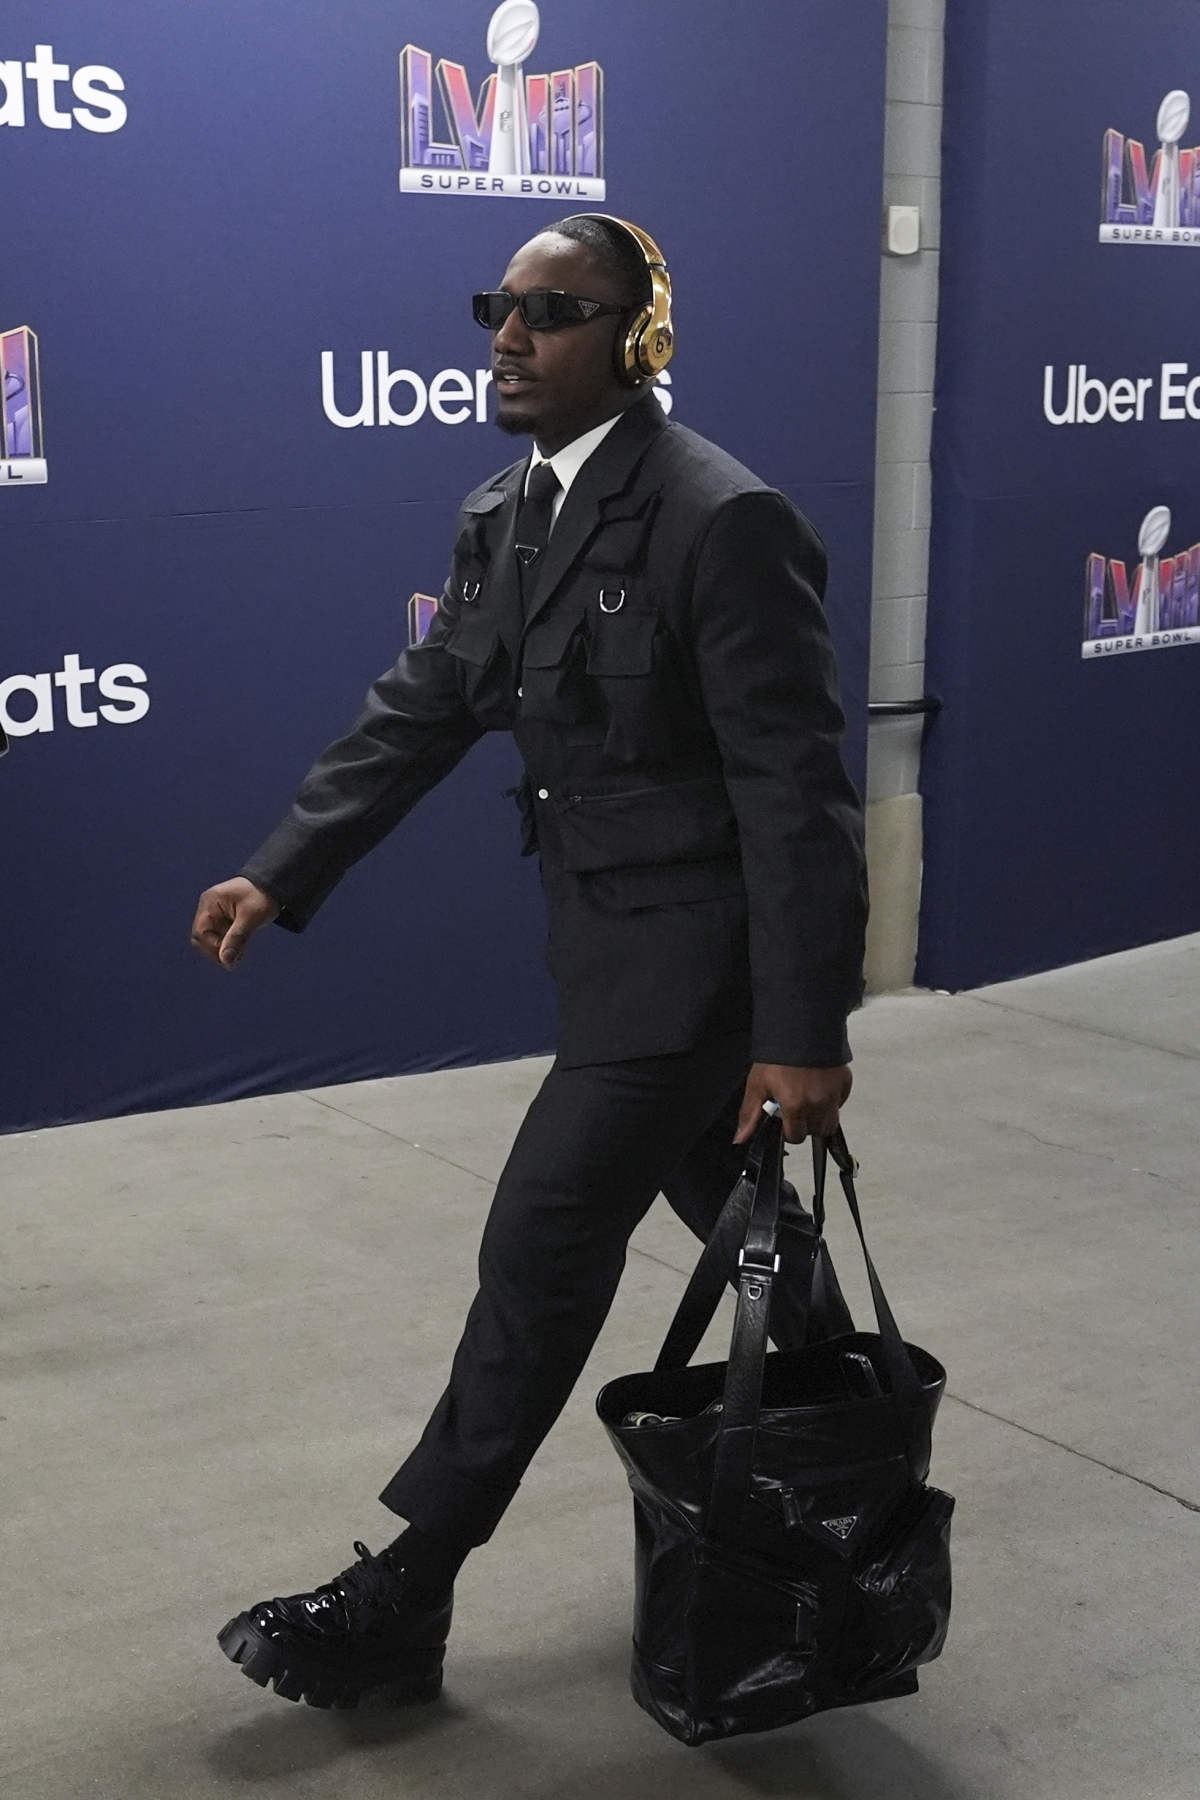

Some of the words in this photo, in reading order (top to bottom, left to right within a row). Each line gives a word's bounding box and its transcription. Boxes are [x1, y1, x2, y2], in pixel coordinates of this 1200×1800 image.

[421, 174, 505, 192] SUPER
[521, 179, 588, 196] BOWL
[1112, 228, 1163, 241] SUPER
[1043, 364, 1153, 425] Uber
[1094, 637, 1143, 653] SUPER
[1152, 632, 1192, 646] BOWL
